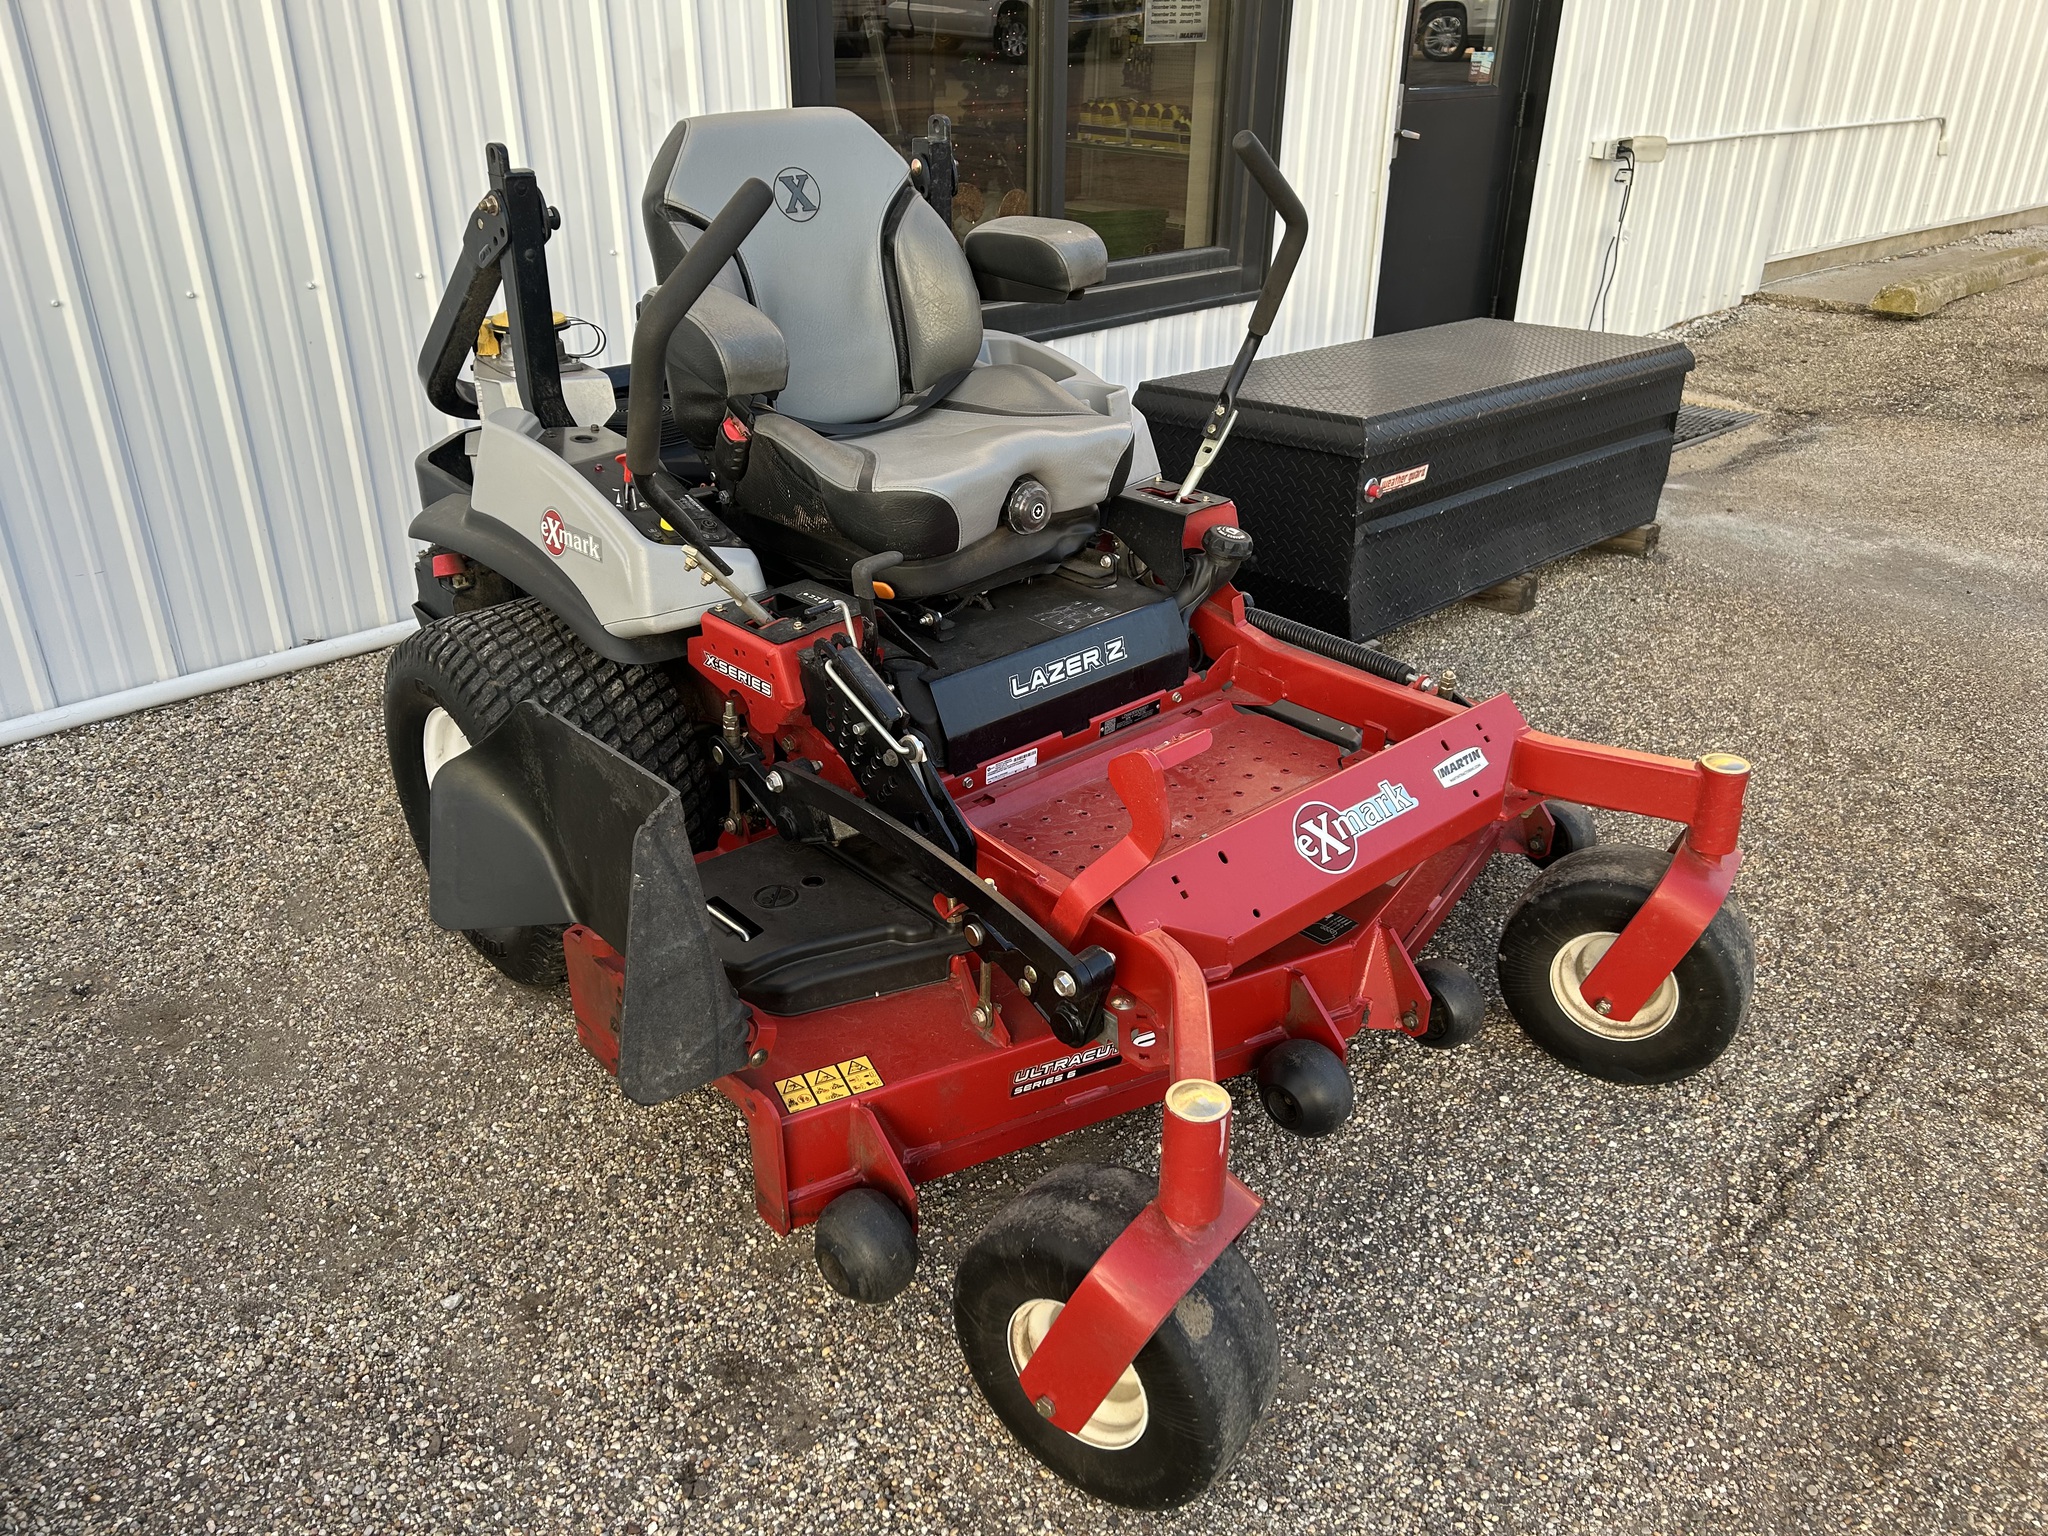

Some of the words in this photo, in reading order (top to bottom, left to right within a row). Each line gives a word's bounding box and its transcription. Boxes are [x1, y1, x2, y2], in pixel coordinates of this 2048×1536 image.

[779, 174, 817, 214] X
[703, 651, 773, 698] X-SERIES
[1009, 646, 1105, 699] LAZER
[1104, 636, 1127, 665] Z
[1438, 748, 1481, 780] MARTIN
[1013, 1074, 1063, 1096] SERIES
[1066, 1070, 1077, 1079] 6
